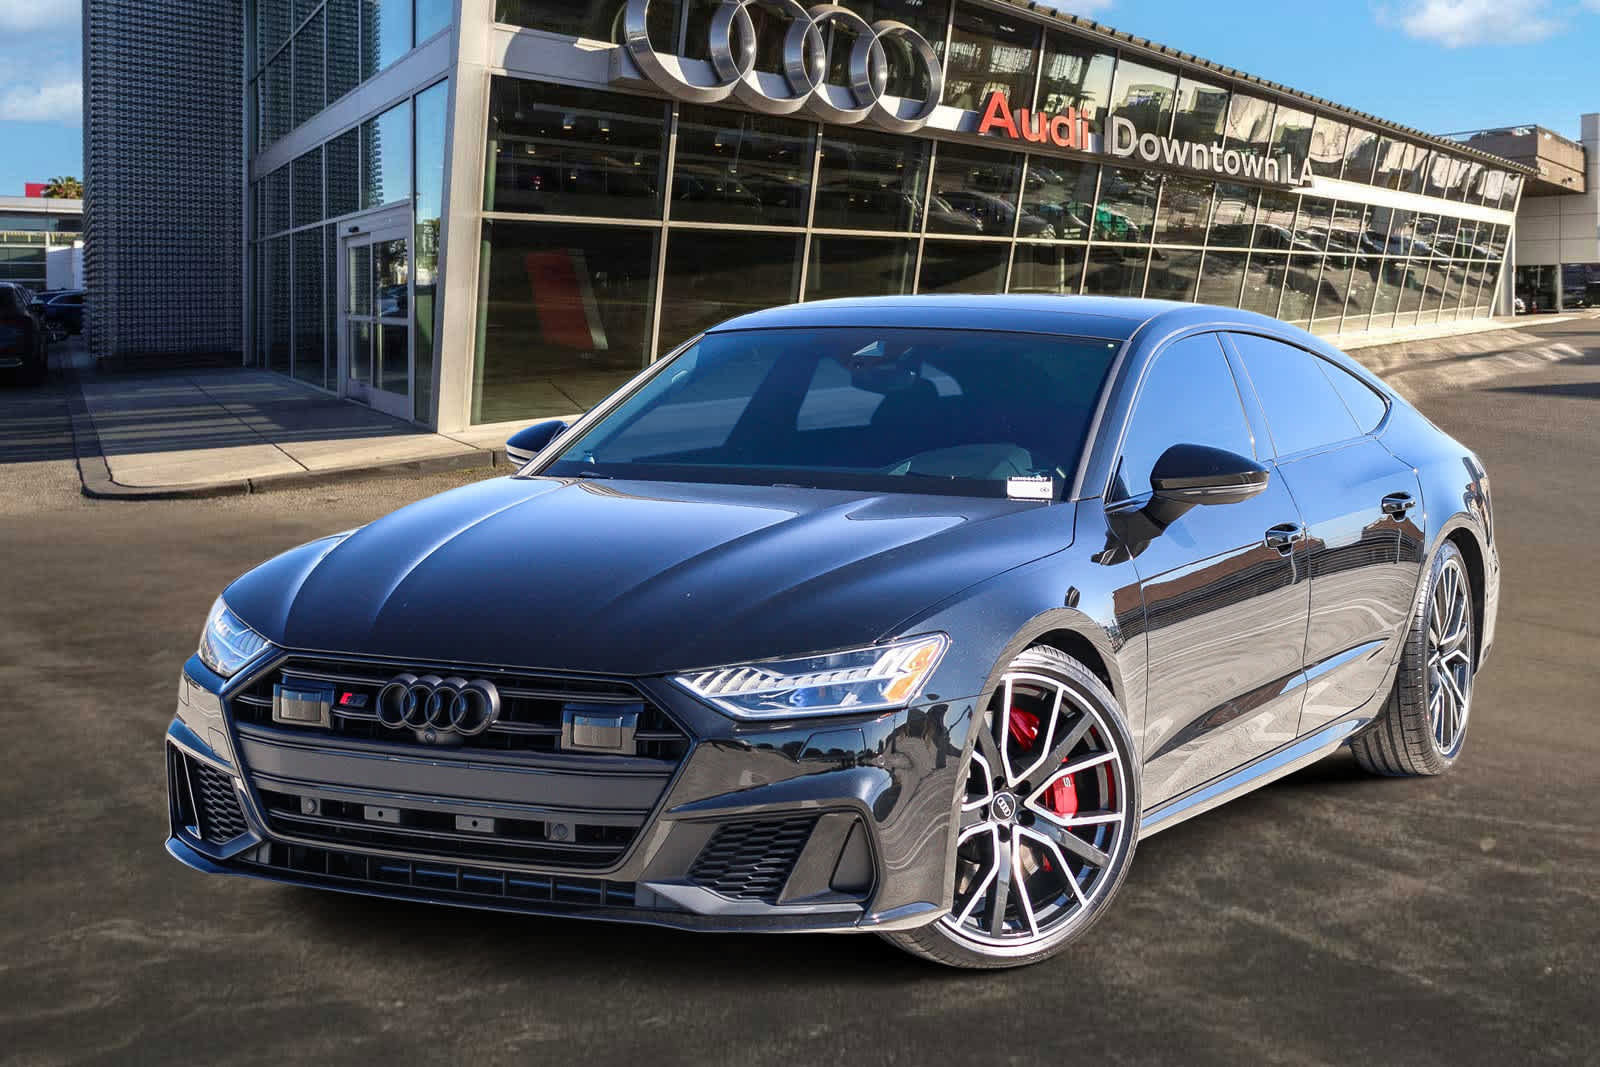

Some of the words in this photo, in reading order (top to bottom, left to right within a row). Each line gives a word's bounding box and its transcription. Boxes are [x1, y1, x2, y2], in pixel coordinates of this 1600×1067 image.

[978, 91, 1089, 150] Audi
[1106, 115, 1279, 181] Downtown
[1286, 153, 1316, 188] LA
